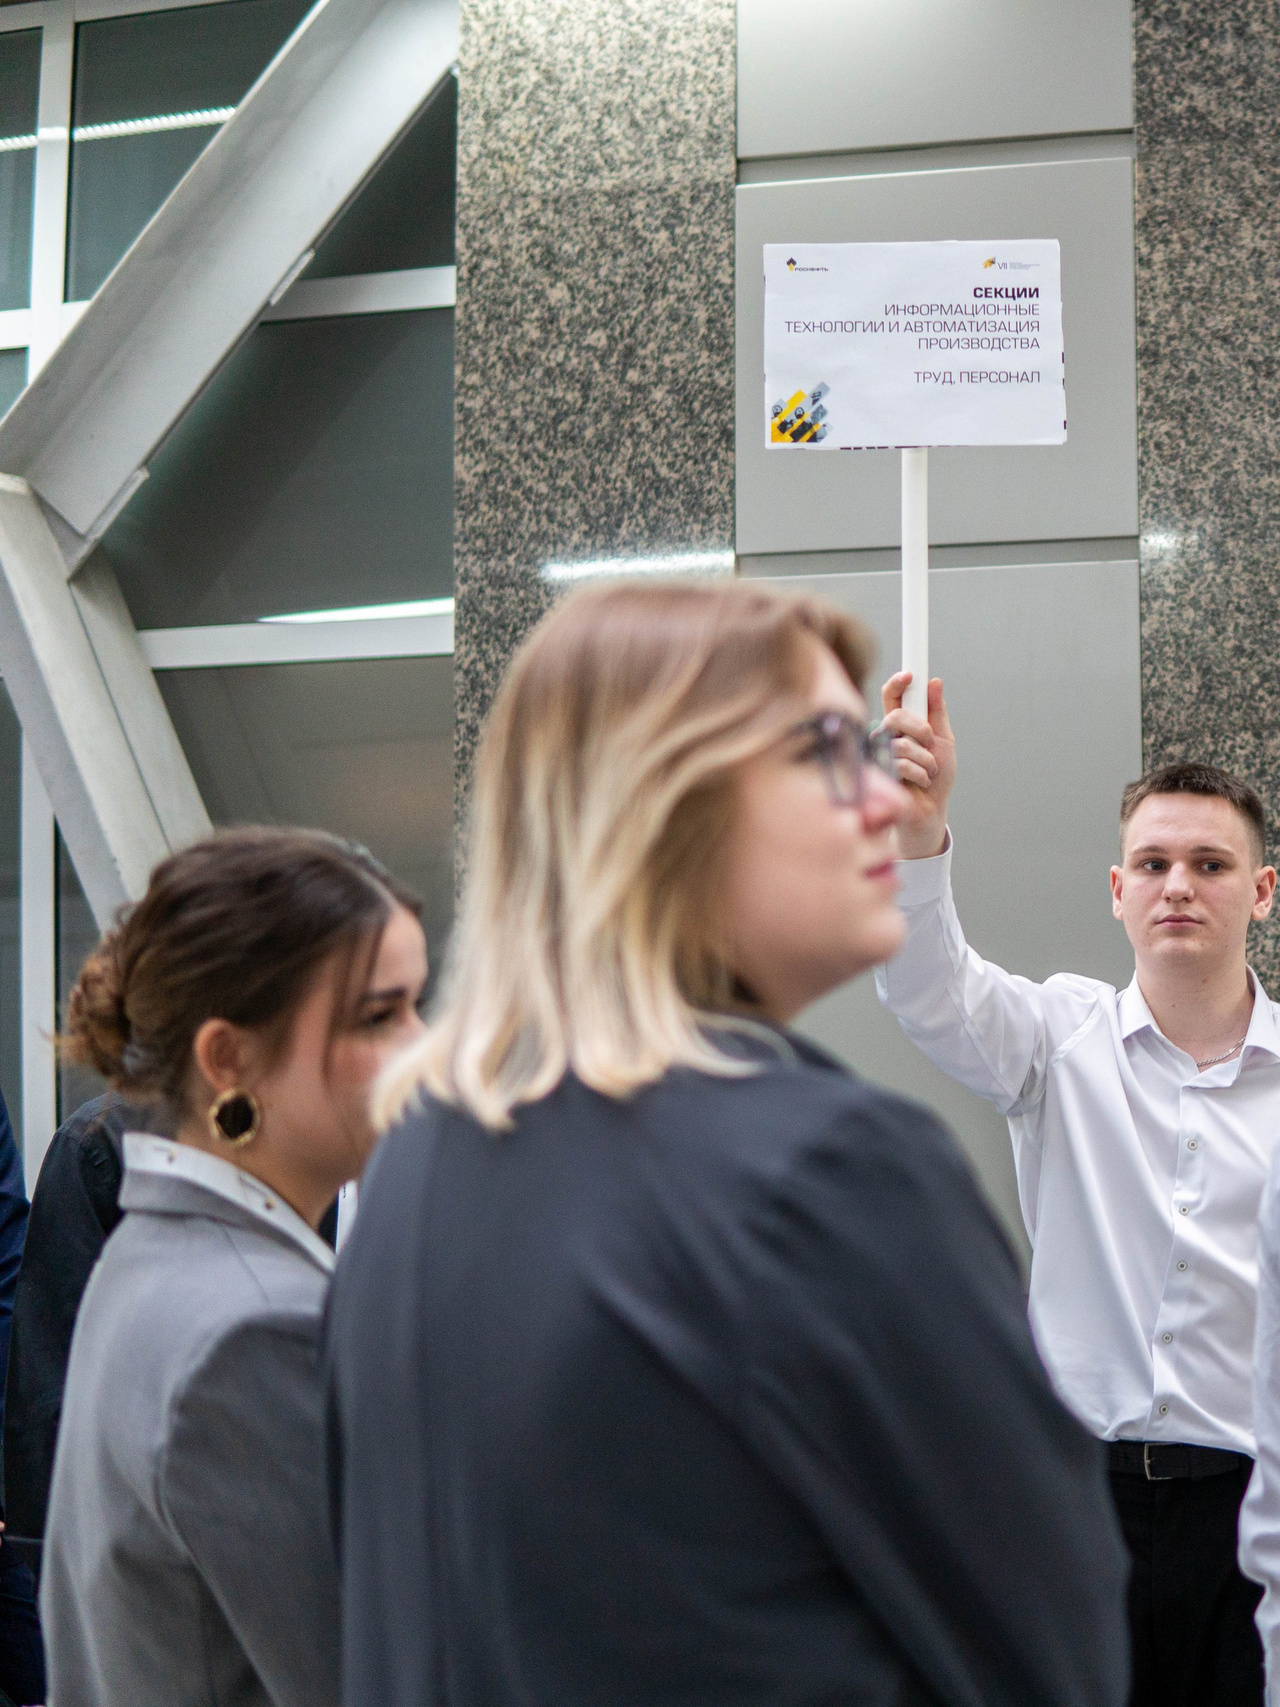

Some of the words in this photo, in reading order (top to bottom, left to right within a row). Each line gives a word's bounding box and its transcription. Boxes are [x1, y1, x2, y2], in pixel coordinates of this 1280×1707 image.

[973, 287, 1039, 300] СЕКЦИИ
[885, 304, 1039, 318] ИНФОРМАЦИОННЫЕ
[785, 321, 885, 333] ТЕХНОЛОГИИ
[889, 321, 900, 333] И
[904, 321, 1040, 335] АВТОМАТИЗАЦИЯ
[918, 337, 1040, 351] ПРОИЗВОДСТВА
[914, 372, 955, 385] ТРУД,
[959, 371, 1040, 384] ПЕРСОНАЛ
